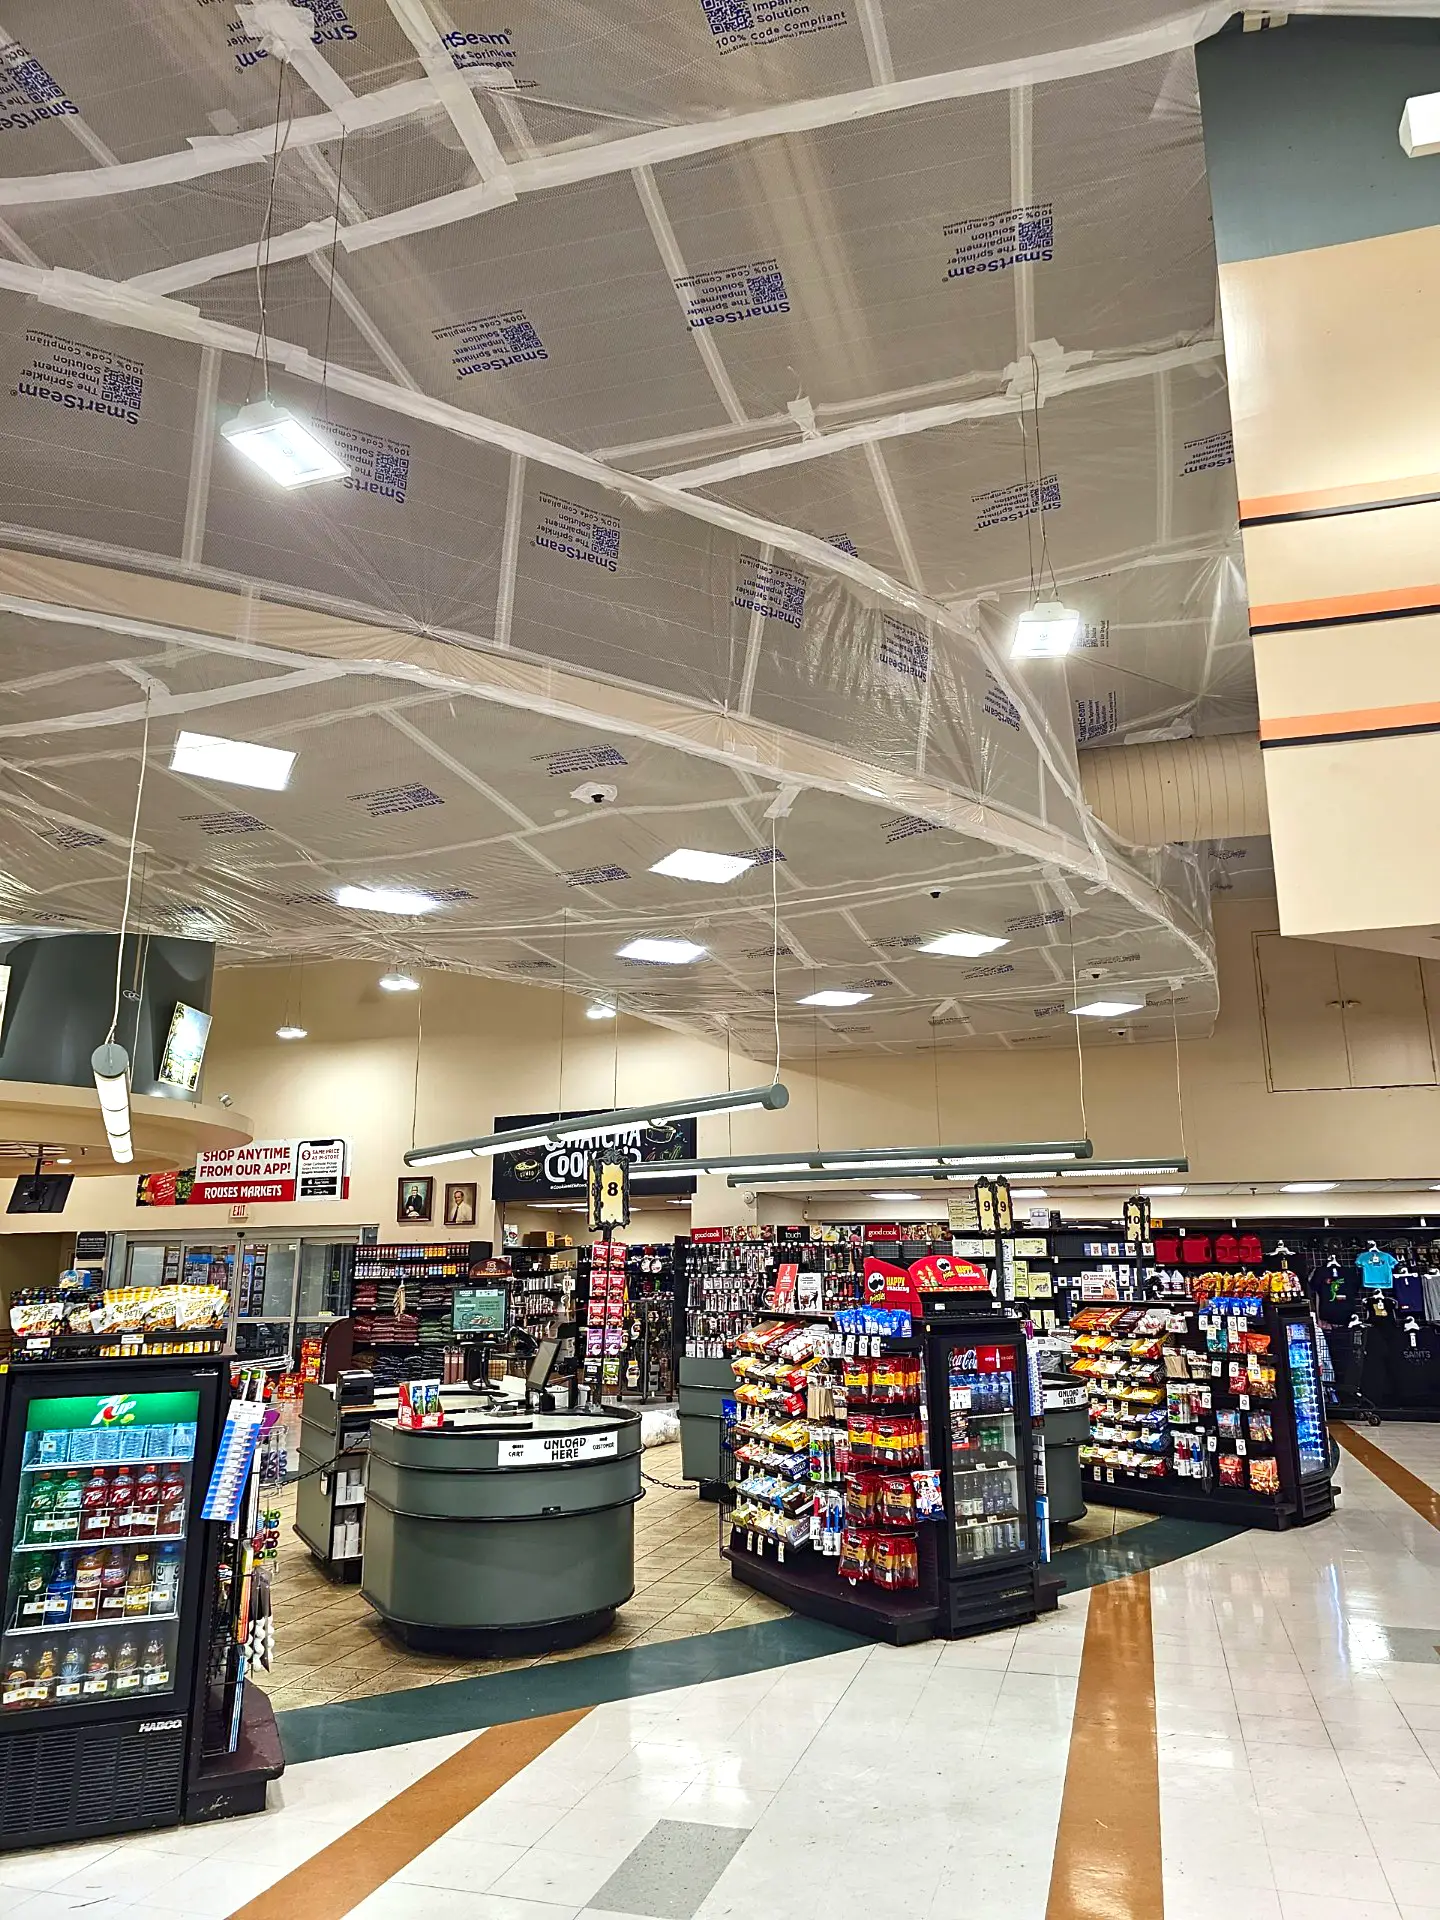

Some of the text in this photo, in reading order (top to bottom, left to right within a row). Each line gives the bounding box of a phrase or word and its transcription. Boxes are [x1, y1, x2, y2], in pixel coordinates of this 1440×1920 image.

[757, 5, 810, 23] Solution
[715, 11, 847, 49] 100% Code Compliant
[441, 31, 511, 51] rtSeam
[466, 50, 518, 61] Sprinkler
[1025, 209, 1053, 218] 100%
[943, 221, 996, 237] Compliant
[971, 225, 1017, 241] Solution
[955, 234, 1017, 255] Impairment
[946, 245, 1017, 265] The Sprinkler
[753, 263, 780, 274] 100%
[947, 249, 1054, 278] SmartSeam
[725, 269, 751, 279] Code
[675, 275, 723, 290] Compliant
[701, 281, 745, 294] Solution
[689, 289, 748, 307] Impairment
[686, 298, 751, 316] The Sprinkler
[689, 301, 791, 328] SmartSeam
[479, 319, 502, 329] Code
[503, 313, 528, 324] 100%
[434, 324, 478, 341] Compliant
[461, 329, 501, 344] Solution
[25, 334, 81, 356] Compliant
[453, 338, 506, 356] Impairment
[85, 351, 113, 365] Code
[452, 347, 511, 365] The Sprinkler
[457, 348, 549, 377] SmartSeam
[52, 354, 102, 375] Solution
[116, 360, 144, 376] 100%
[33, 360, 100, 386] Impairment
[20, 368, 99, 396] The Sprinkler
[18, 382, 140, 426] SmartSeam
[360, 436, 384, 449] Code
[387, 443, 411, 457] 100%
[539, 495, 579, 516] Compliant
[558, 513, 592, 531] Solution
[579, 510, 600, 522] Code
[536, 524, 591, 549] The Sprinkler
[544, 517, 592, 540] Impairment
[535, 535, 618, 573] SmartSeam
[735, 585, 768, 601] Sprinkler
[743, 579, 784, 598] Impairment
[733, 596, 802, 630] SmartSeam
[879, 653, 927, 683] SmartSeam
[984, 703, 1021, 732] SmartSeam
[1077, 701, 1087, 743] SmartSeam
[549, 761, 629, 775] SmartSeam
[370, 798, 445, 816] SmartSeam
[203, 1147, 291, 1162] SHOP ANYTIME
[200, 1164, 232, 1178] FROM
[236, 1163, 262, 1177] OUR
[264, 1162, 291, 1175] APP!
[204, 1184, 292, 1199] ROUSES MARKETS
[607, 1182, 619, 1196] 8
[232, 1204, 246, 1217] EXIT
[983, 1200, 991, 1212] 9
[1000, 1200, 1007, 1212] 9
[1127, 1216, 1140, 1225] 10
[785, 1231, 802, 1240] touch
[886, 1276, 906, 1287] HAPPY
[1403, 1350, 1431, 1359] SAINTS
[1058, 1389, 1079, 1398] UNLOAD
[90, 1394, 137, 1426] 7UP
[543, 1437, 587, 1450] UNLOAD
[592, 1442, 615, 1450] CUSTOMER
[551, 1448, 579, 1461] HERE
[138, 1719, 183, 1733] HABCO
